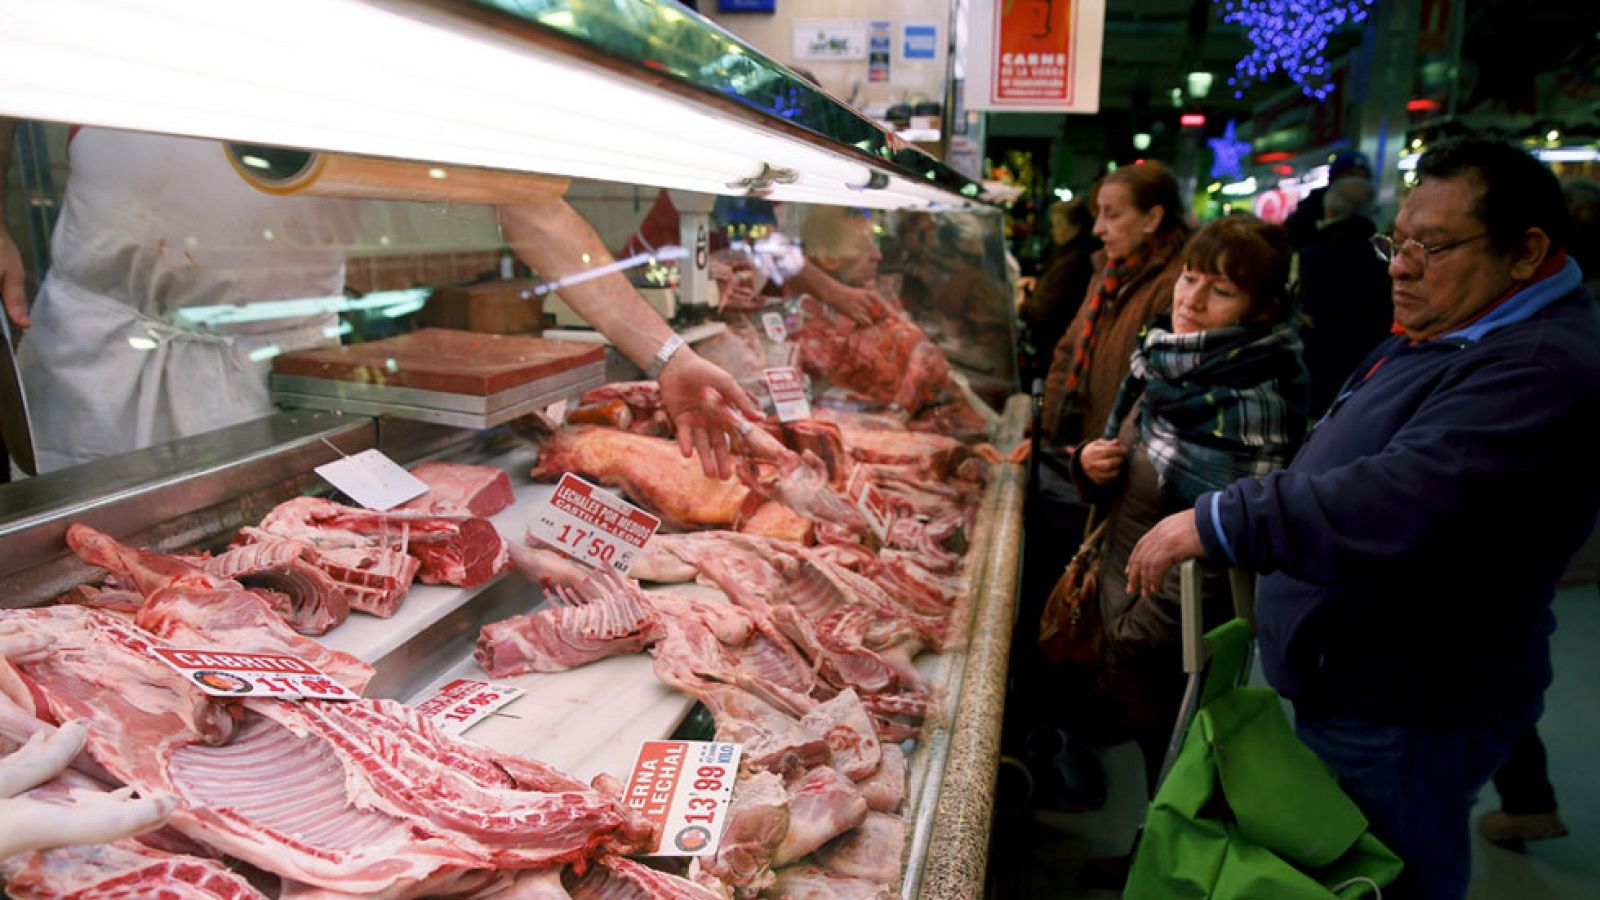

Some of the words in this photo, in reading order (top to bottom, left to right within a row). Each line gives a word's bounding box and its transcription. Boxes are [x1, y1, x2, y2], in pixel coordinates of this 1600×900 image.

[1003, 52, 1066, 66] CARNE
[172, 651, 305, 672] CABRITO
[629, 759, 659, 811] ERNA
[647, 744, 684, 816] LECHAL
